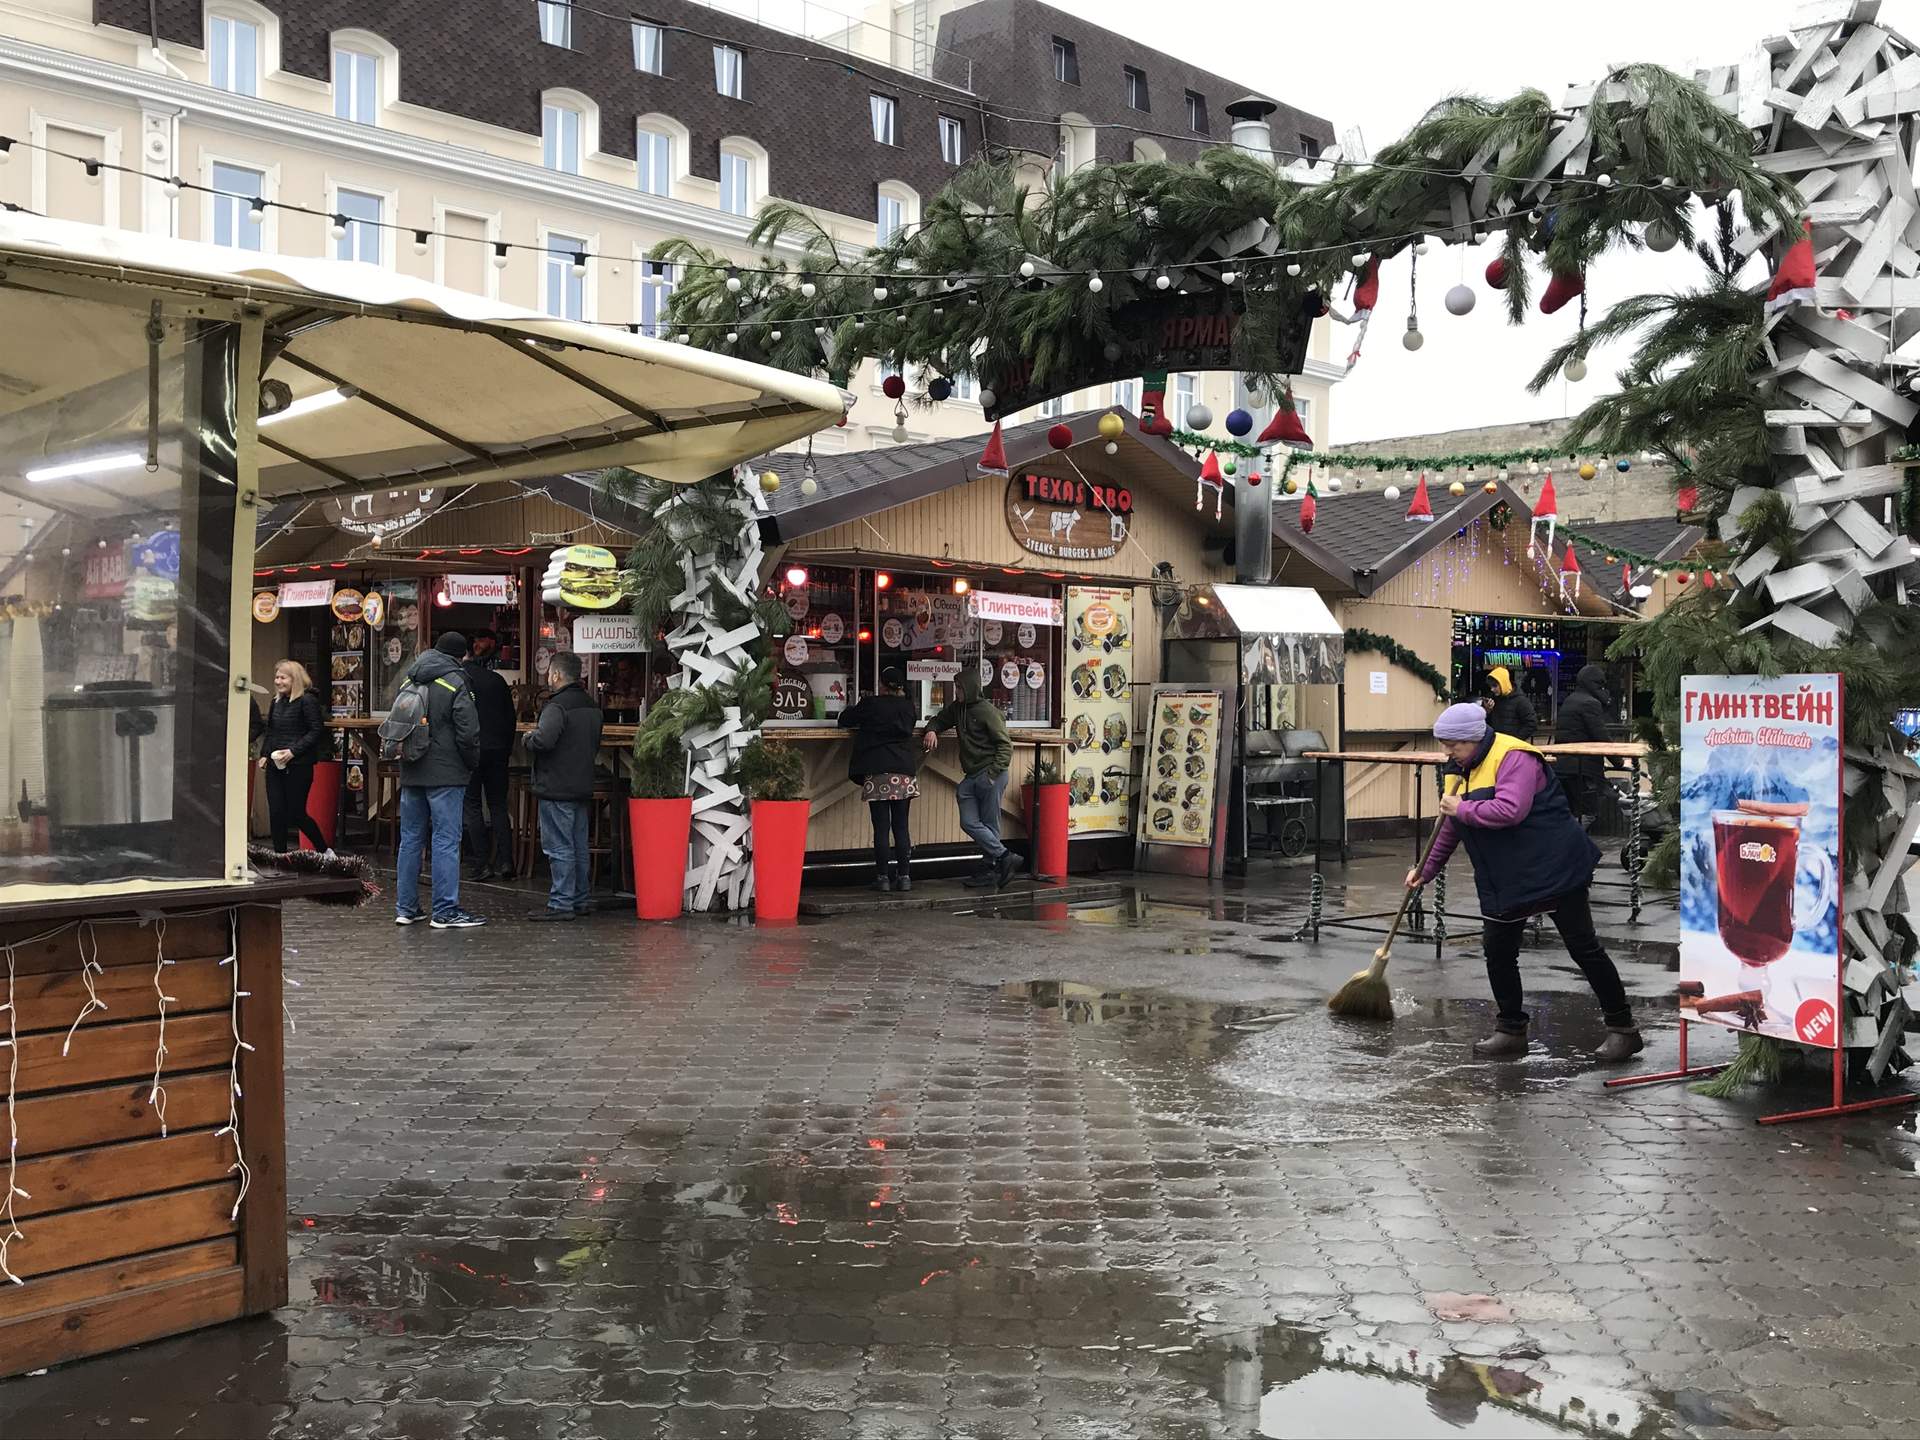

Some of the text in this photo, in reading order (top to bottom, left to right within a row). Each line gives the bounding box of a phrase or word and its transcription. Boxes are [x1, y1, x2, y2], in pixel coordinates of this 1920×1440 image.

[1162, 315, 1239, 350] ЯРМА
[1026, 474, 1134, 513] TEXAS BBQ
[368, 519, 399, 534] BUERS
[406, 508, 422, 524] MOR
[1058, 546, 1089, 558] BURGERS
[1090, 550, 1096, 558] &
[1097, 545, 1116, 558] MORE
[284, 584, 327, 602] Глинтвейн
[450, 580, 503, 597] Глинтвейн
[980, 597, 1048, 618] Глинтвейн
[582, 627, 640, 640] ШАШЛЫ
[591, 641, 636, 650] ВКУСНЕЙШИЙ
[908, 663, 961, 673] Welcome to Odessa
[772, 691, 808, 708] ЭЛЬ
[1684, 684, 1834, 726] ГЛИНТВЕЙН
[1704, 726, 1812, 750] Austrian Glühwein
[1802, 1007, 1832, 1041] NEW
